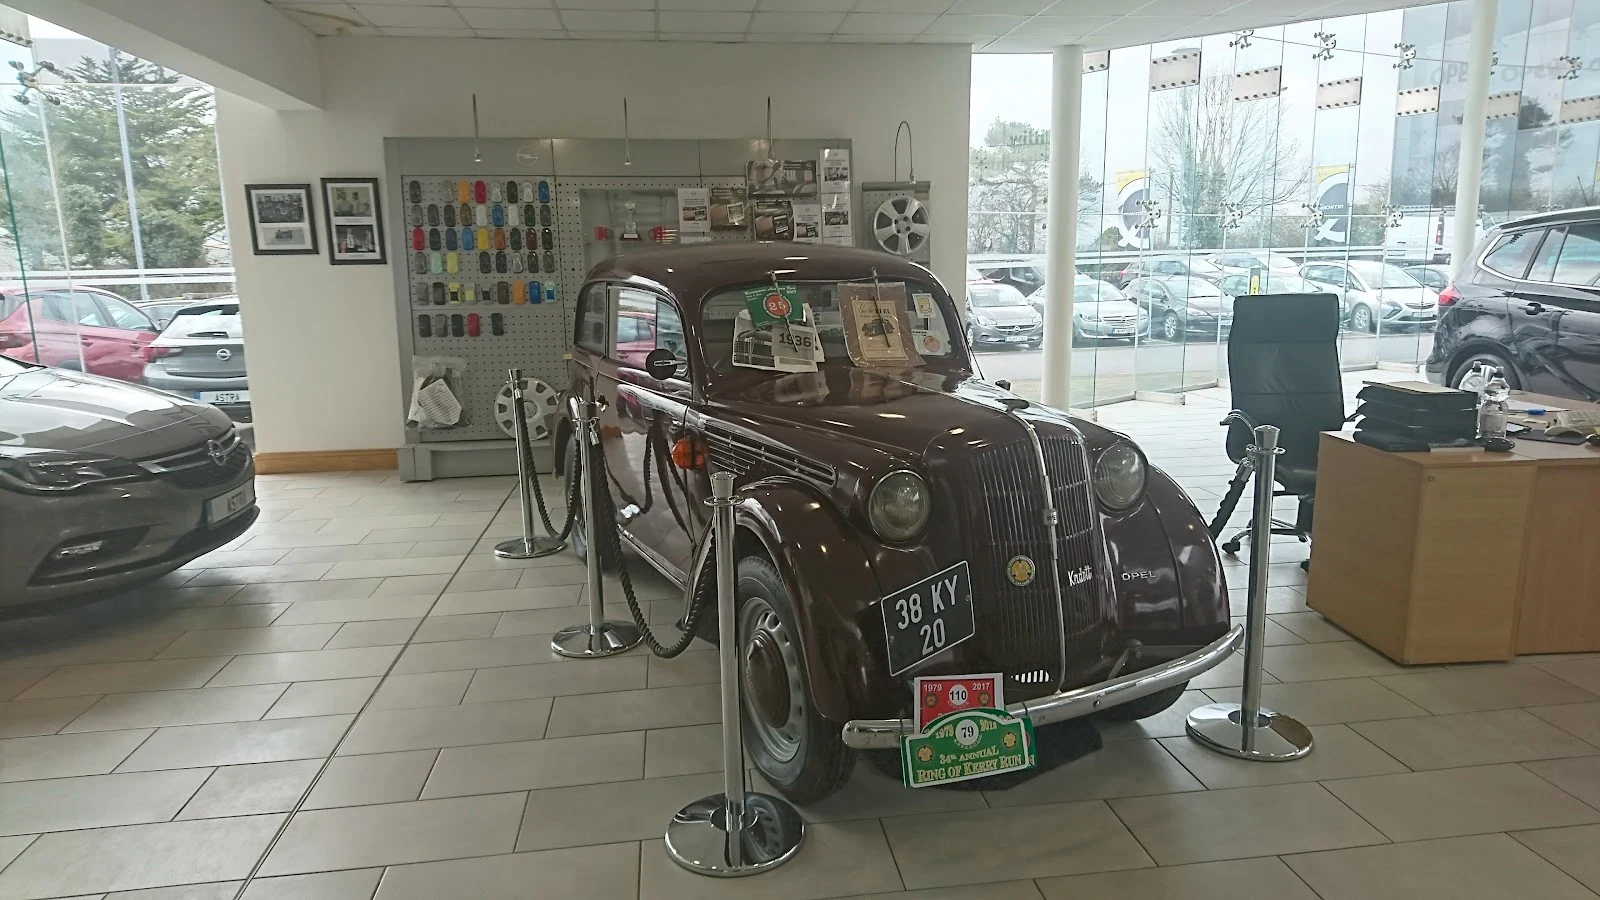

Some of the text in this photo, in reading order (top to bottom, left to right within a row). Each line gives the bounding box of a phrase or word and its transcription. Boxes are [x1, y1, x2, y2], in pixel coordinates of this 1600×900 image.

[779, 332, 812, 348] 1936
[214, 393, 240, 402] ASTRA
[1120, 570, 1157, 581] OPEL
[895, 574, 958, 630] 38 KY
[919, 618, 946, 656] 20
[924, 684, 943, 692] 1979
[972, 682, 991, 691] 2017
[949, 690, 967, 701] 110
[935, 724, 954, 739] 1979
[961, 726, 974, 739] 79
[959, 745, 1000, 761] ANNUAL
[916, 769, 946, 783] RING
[947, 766, 961, 778] OF
[963, 759, 999, 776] KERRY
[999, 755, 1022, 769] RUN
